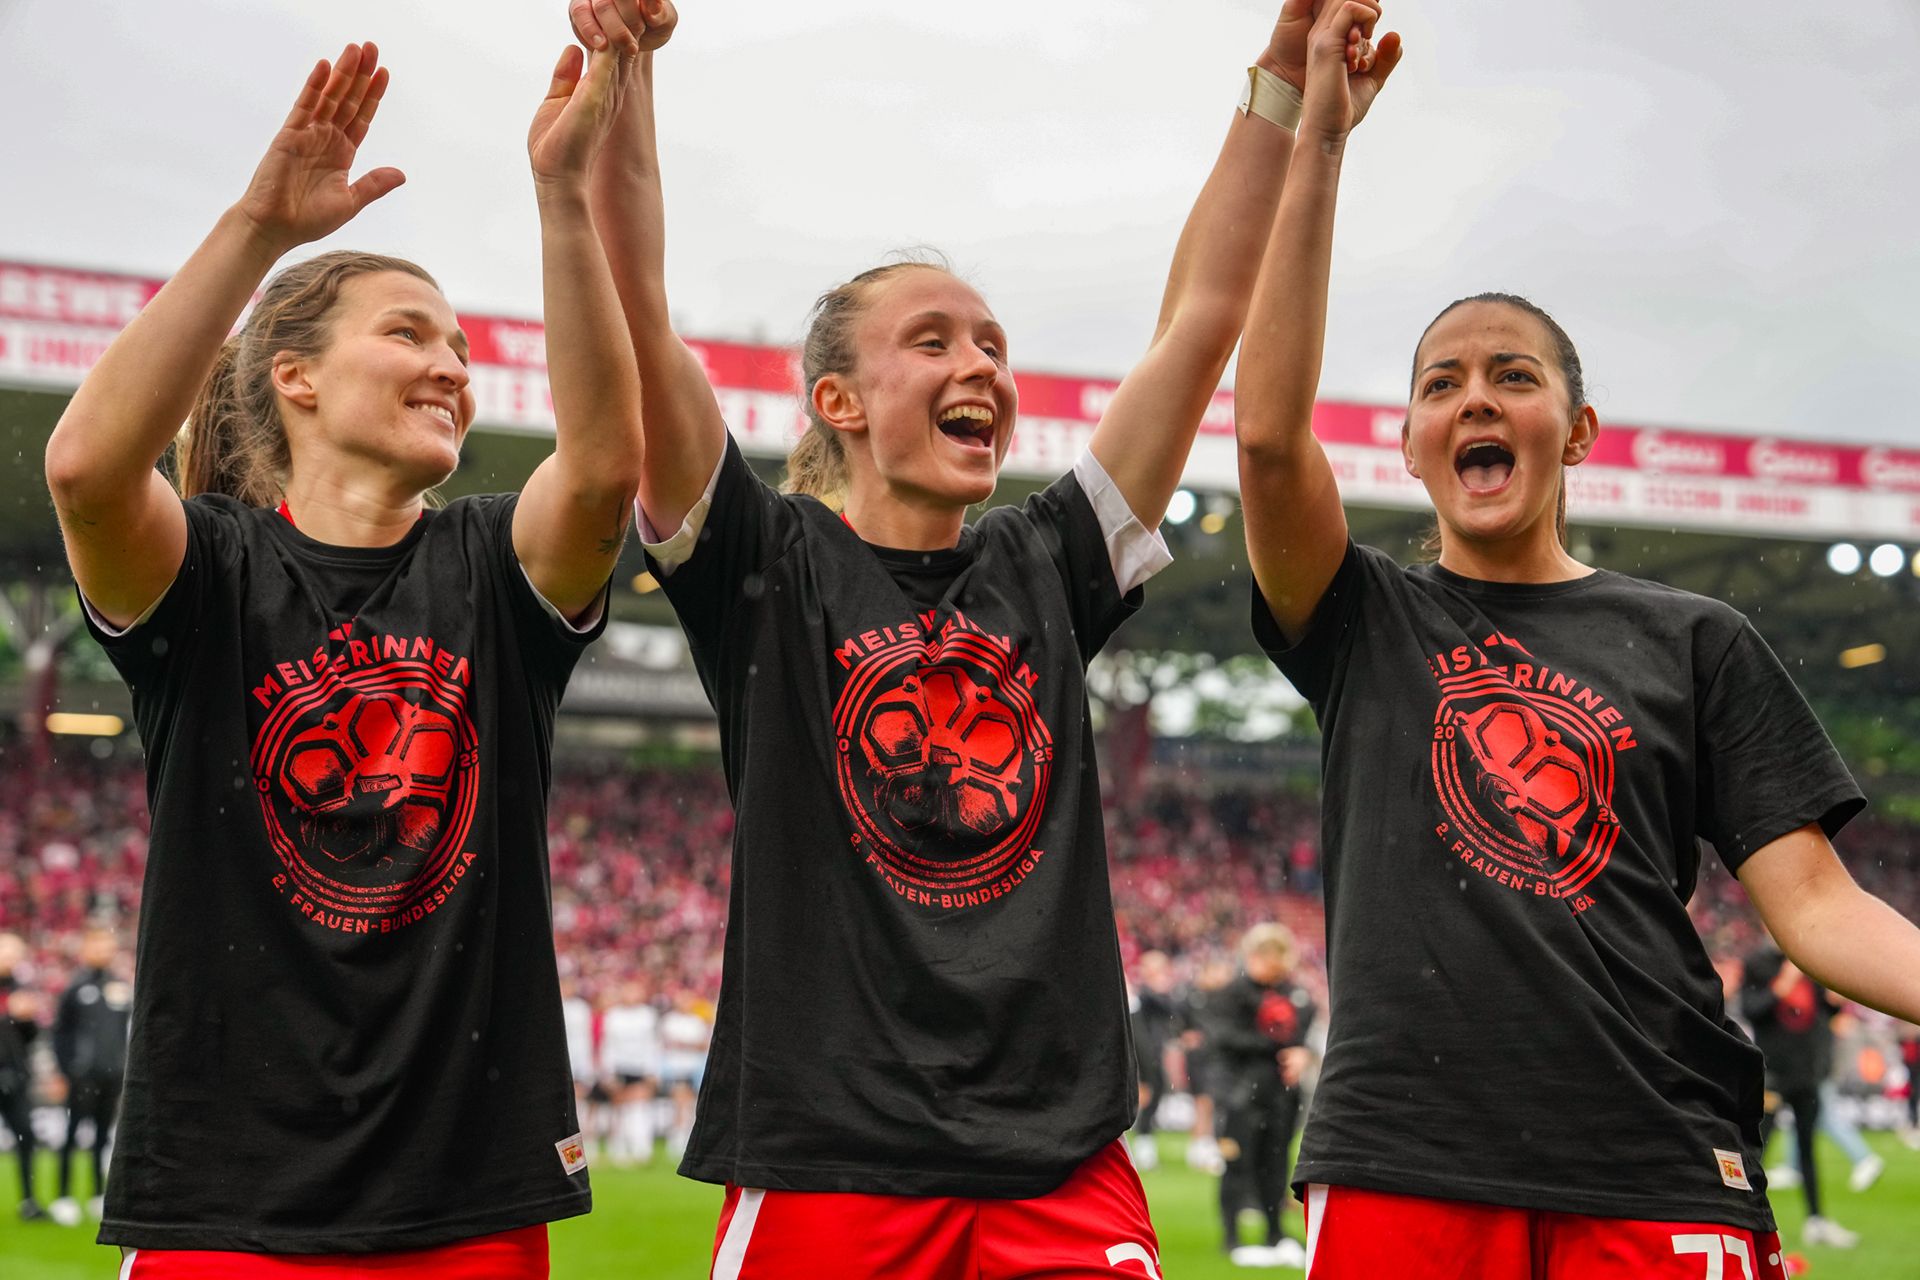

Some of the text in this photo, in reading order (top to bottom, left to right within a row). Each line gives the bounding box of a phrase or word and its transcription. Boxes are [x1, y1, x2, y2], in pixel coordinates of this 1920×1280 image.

[252, 634, 471, 708] MEISERINNEN
[1434, 726, 1455, 740] 20
[460, 749, 479, 767] 25
[1034, 747, 1053, 762] 25
[1435, 822, 1448, 843] 2.
[865, 849, 1044, 908] FRAUEN-BUNDESLIGA
[272, 850, 477, 934] 2. FRAUEN-BUNDESLIGA
